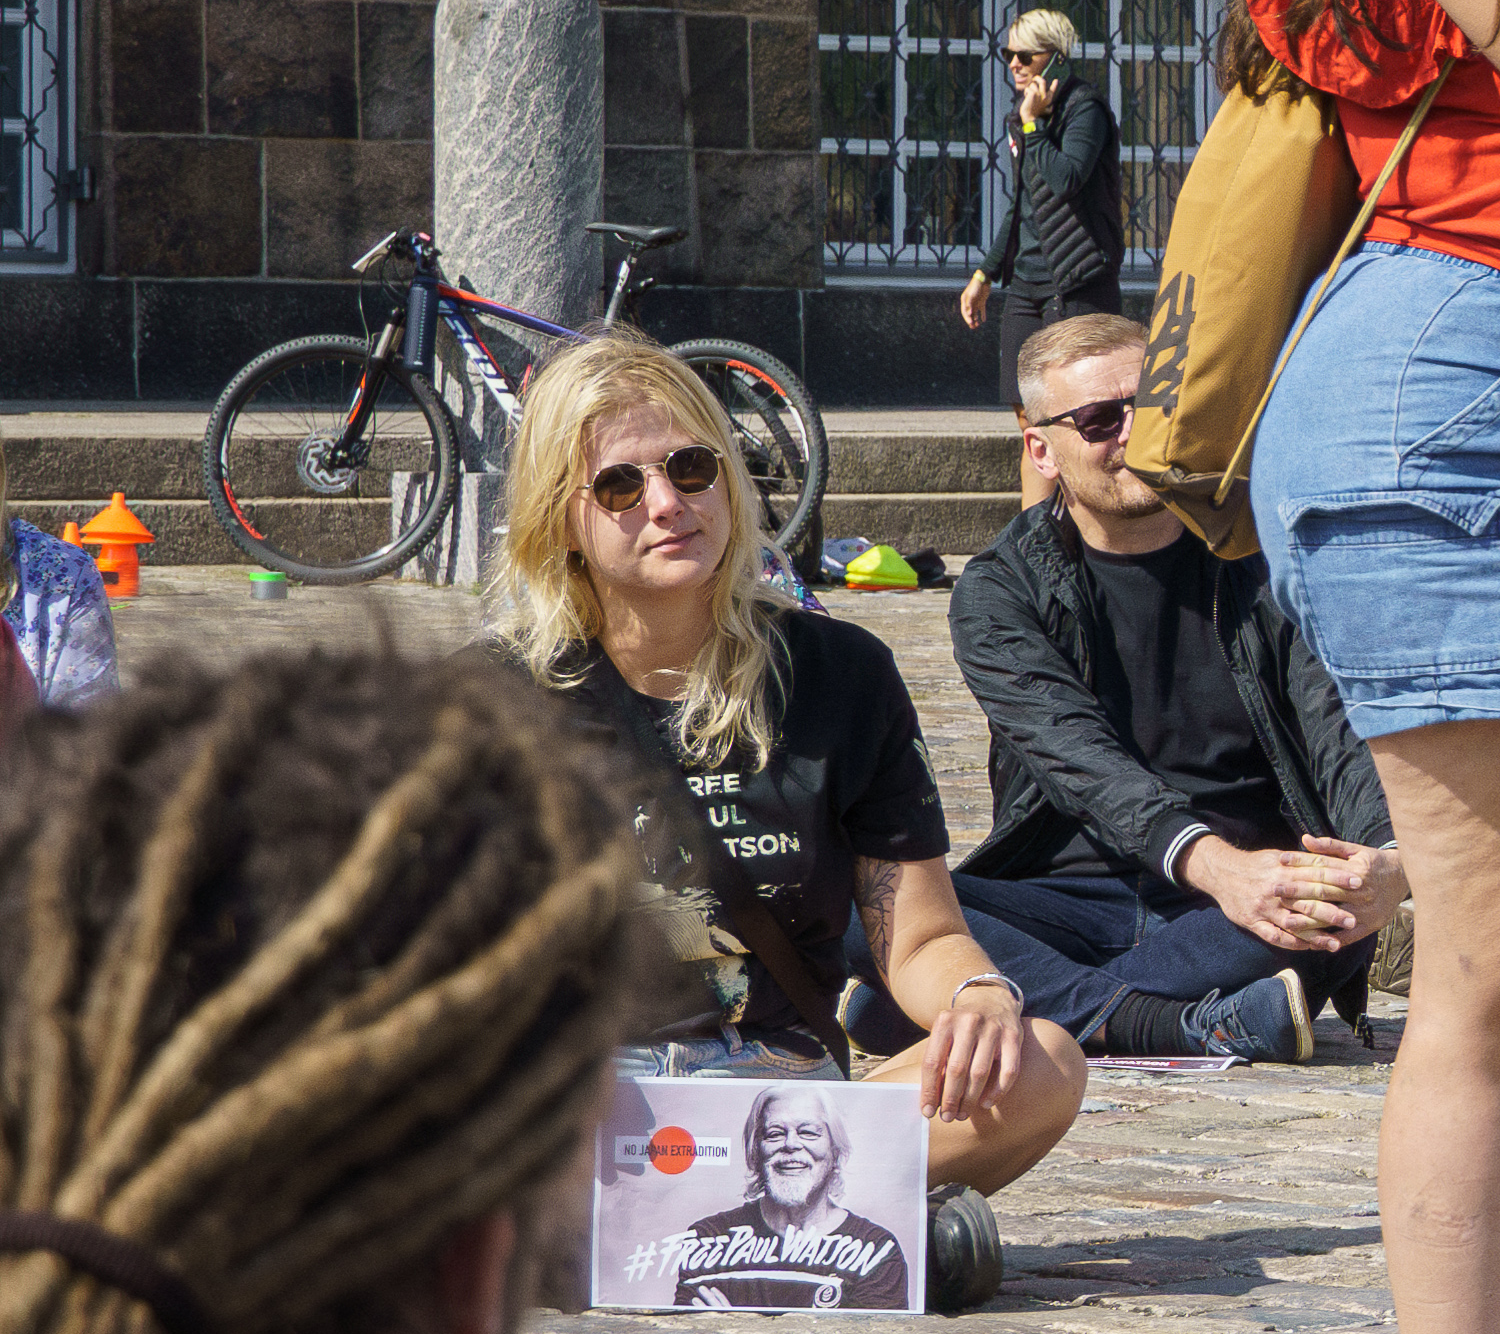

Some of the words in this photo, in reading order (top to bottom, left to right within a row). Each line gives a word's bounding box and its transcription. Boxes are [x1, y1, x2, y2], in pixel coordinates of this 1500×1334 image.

[624, 1144, 637, 1156] NO
[638, 1144, 668, 1157] JAPAN
[670, 1145, 728, 1158] EXTRADITION
